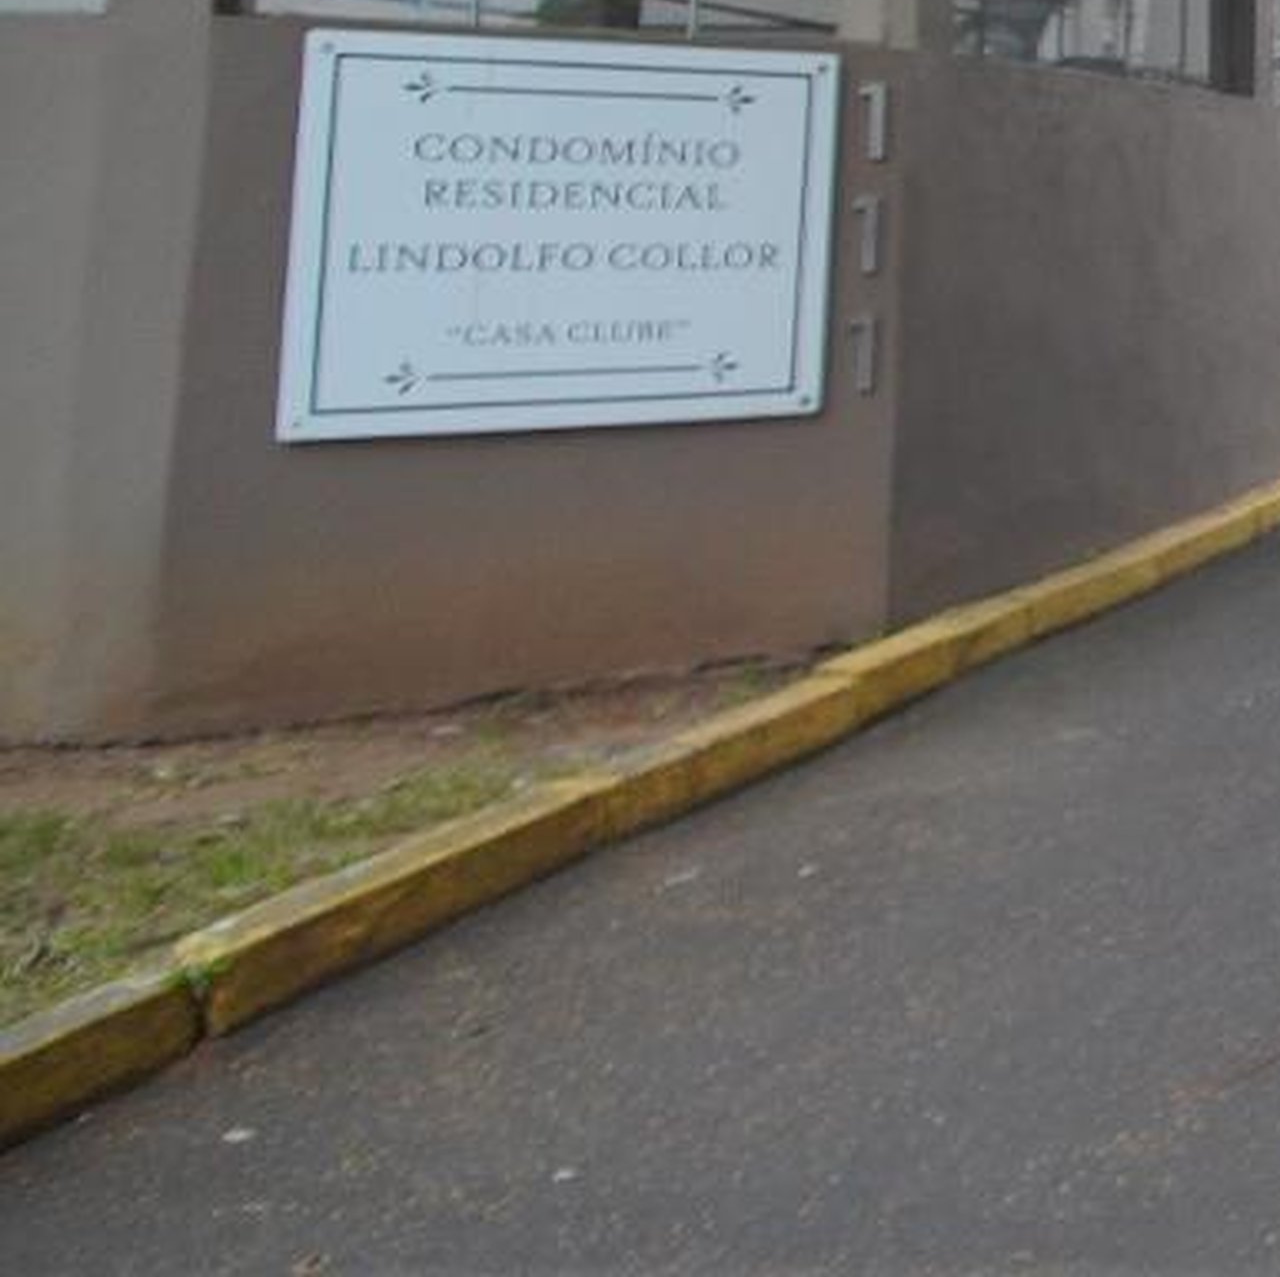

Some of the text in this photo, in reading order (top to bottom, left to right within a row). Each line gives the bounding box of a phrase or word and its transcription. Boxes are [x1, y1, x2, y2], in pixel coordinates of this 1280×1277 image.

[413, 131, 741, 167] CONDOMÍNIO
[424, 179, 726, 213] RESIDENCIAL
[347, 241, 781, 273] LINDOLFO COLLOR
